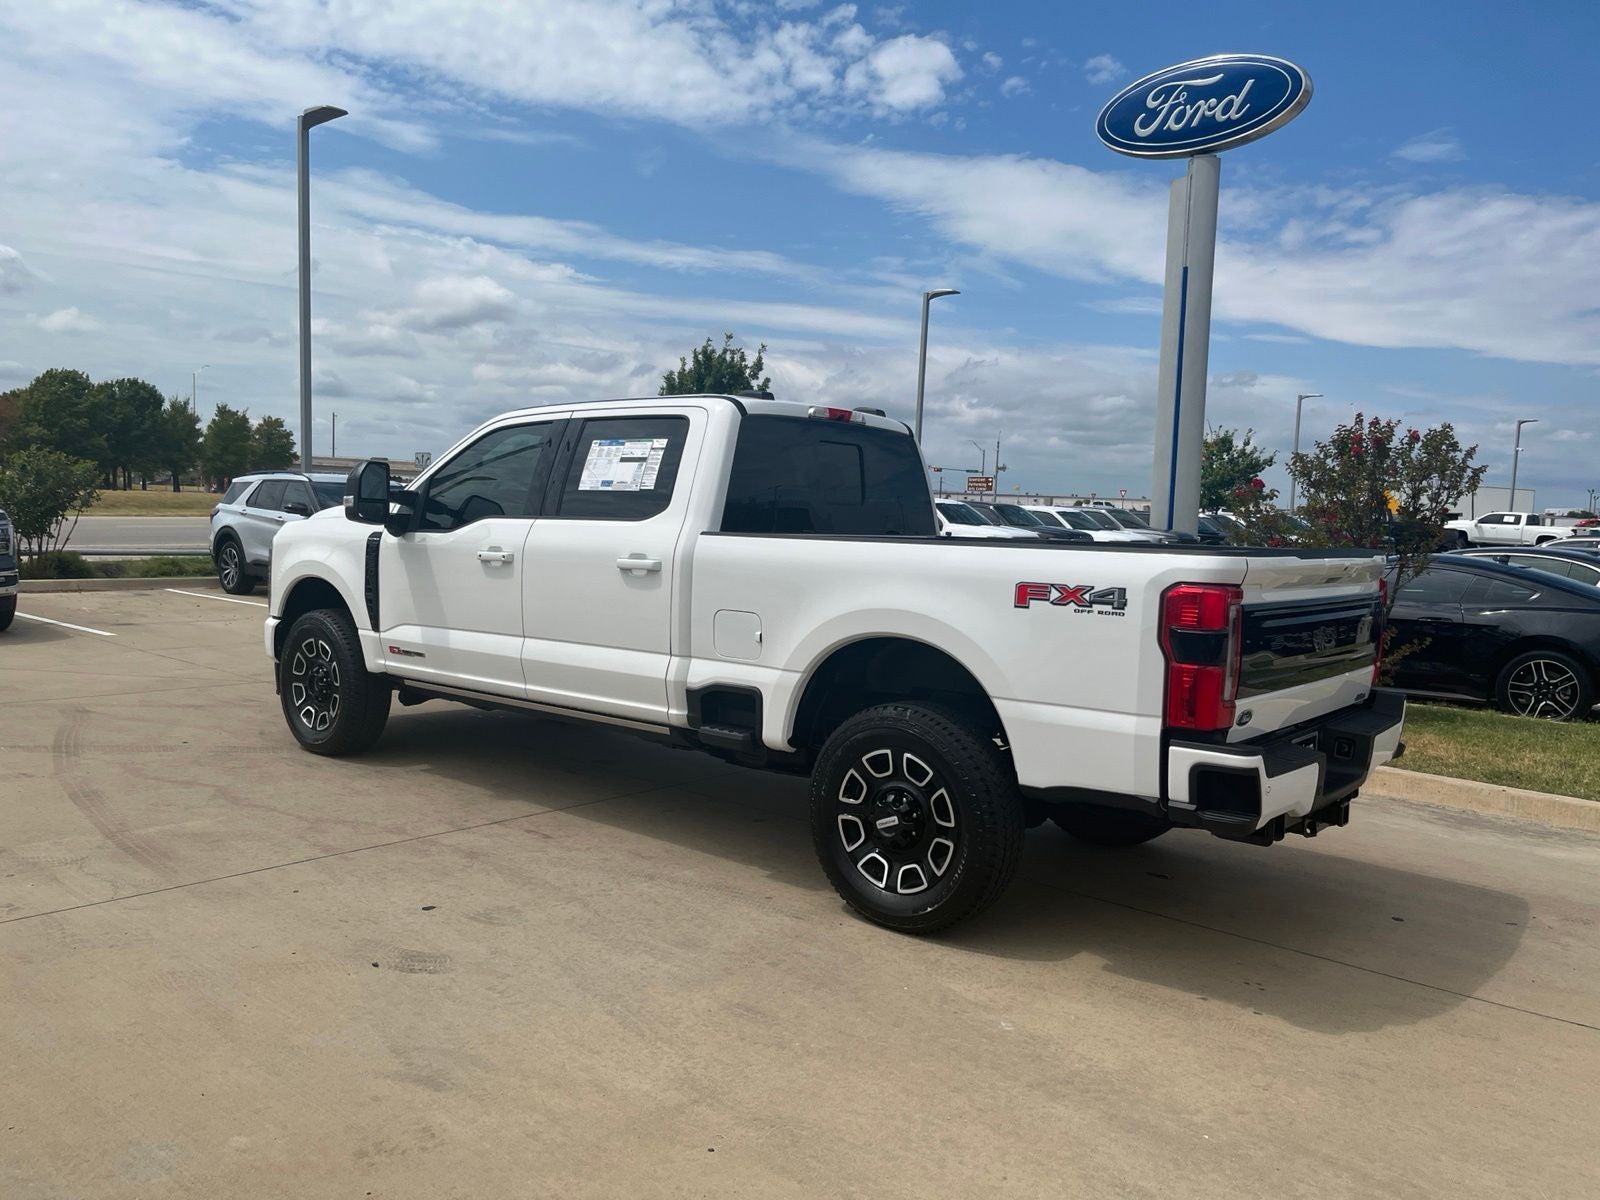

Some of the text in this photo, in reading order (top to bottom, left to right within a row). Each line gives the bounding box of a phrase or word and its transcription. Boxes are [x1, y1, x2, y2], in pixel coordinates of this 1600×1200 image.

[1133, 73, 1255, 138] Ford
[1014, 581, 1128, 610] FX4
[1097, 609, 1126, 617] ROAD
